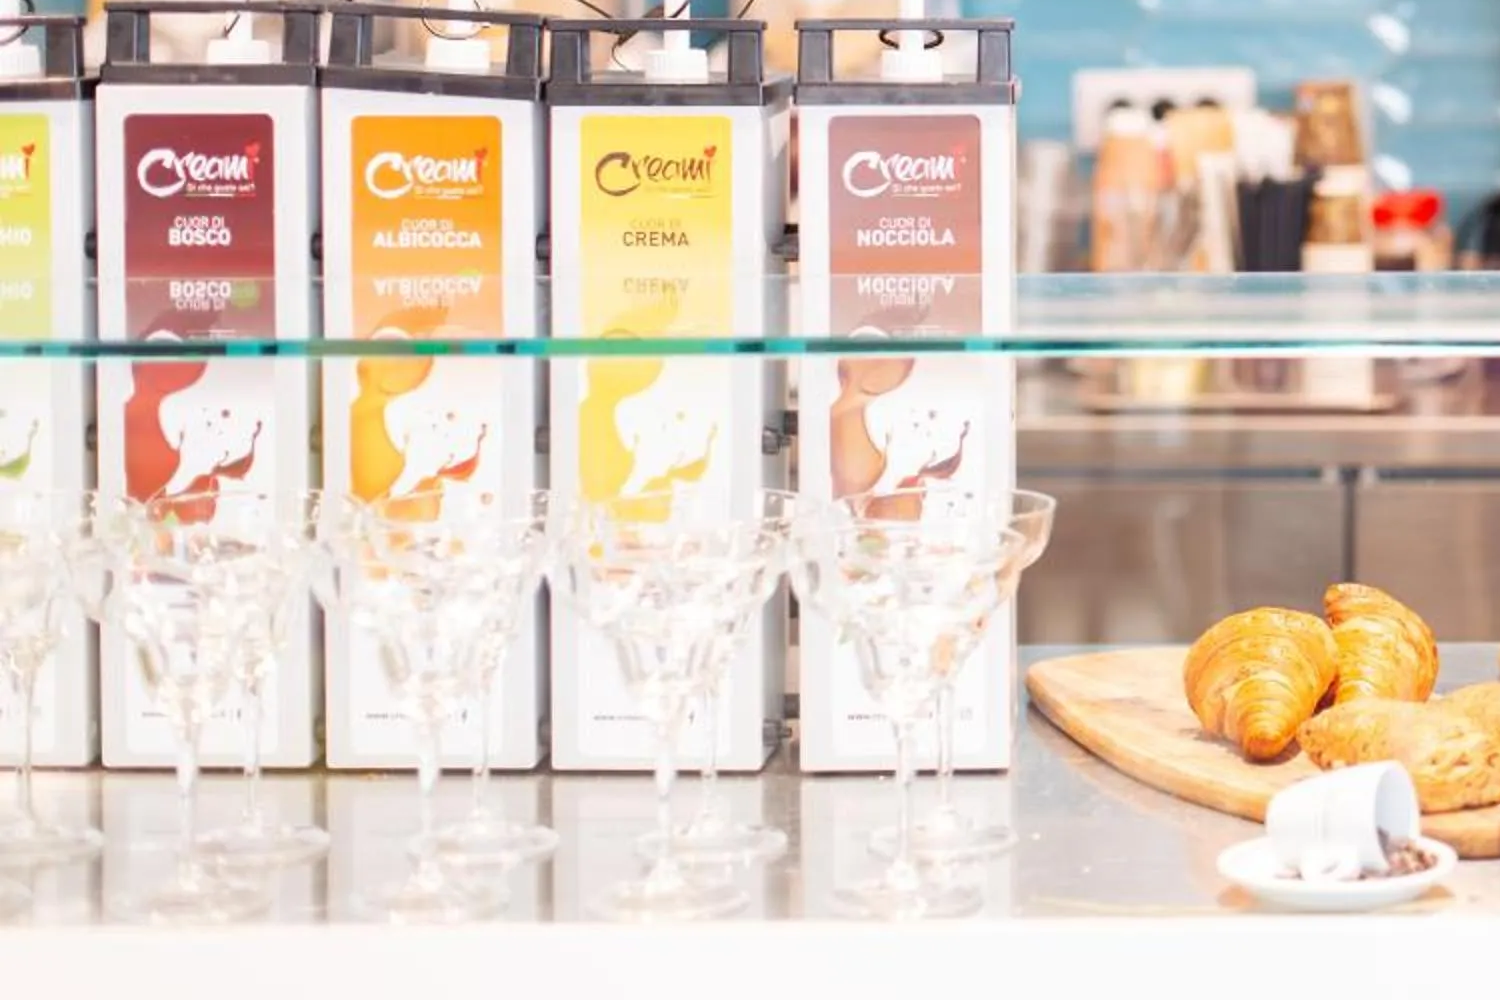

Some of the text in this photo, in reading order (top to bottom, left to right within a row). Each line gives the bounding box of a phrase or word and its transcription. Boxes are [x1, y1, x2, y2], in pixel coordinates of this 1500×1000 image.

[137, 141, 260, 197] Creami
[365, 147, 488, 199] Creami
[595, 145, 717, 197] Creami
[174, 216, 226, 228] CUOR DI
[879, 216, 916, 229] CUOR
[168, 227, 232, 247] BOSCO
[372, 230, 482, 248] ALBICOCCA
[622, 231, 690, 247] CREMA
[856, 228, 956, 247] NOCCIOLA
